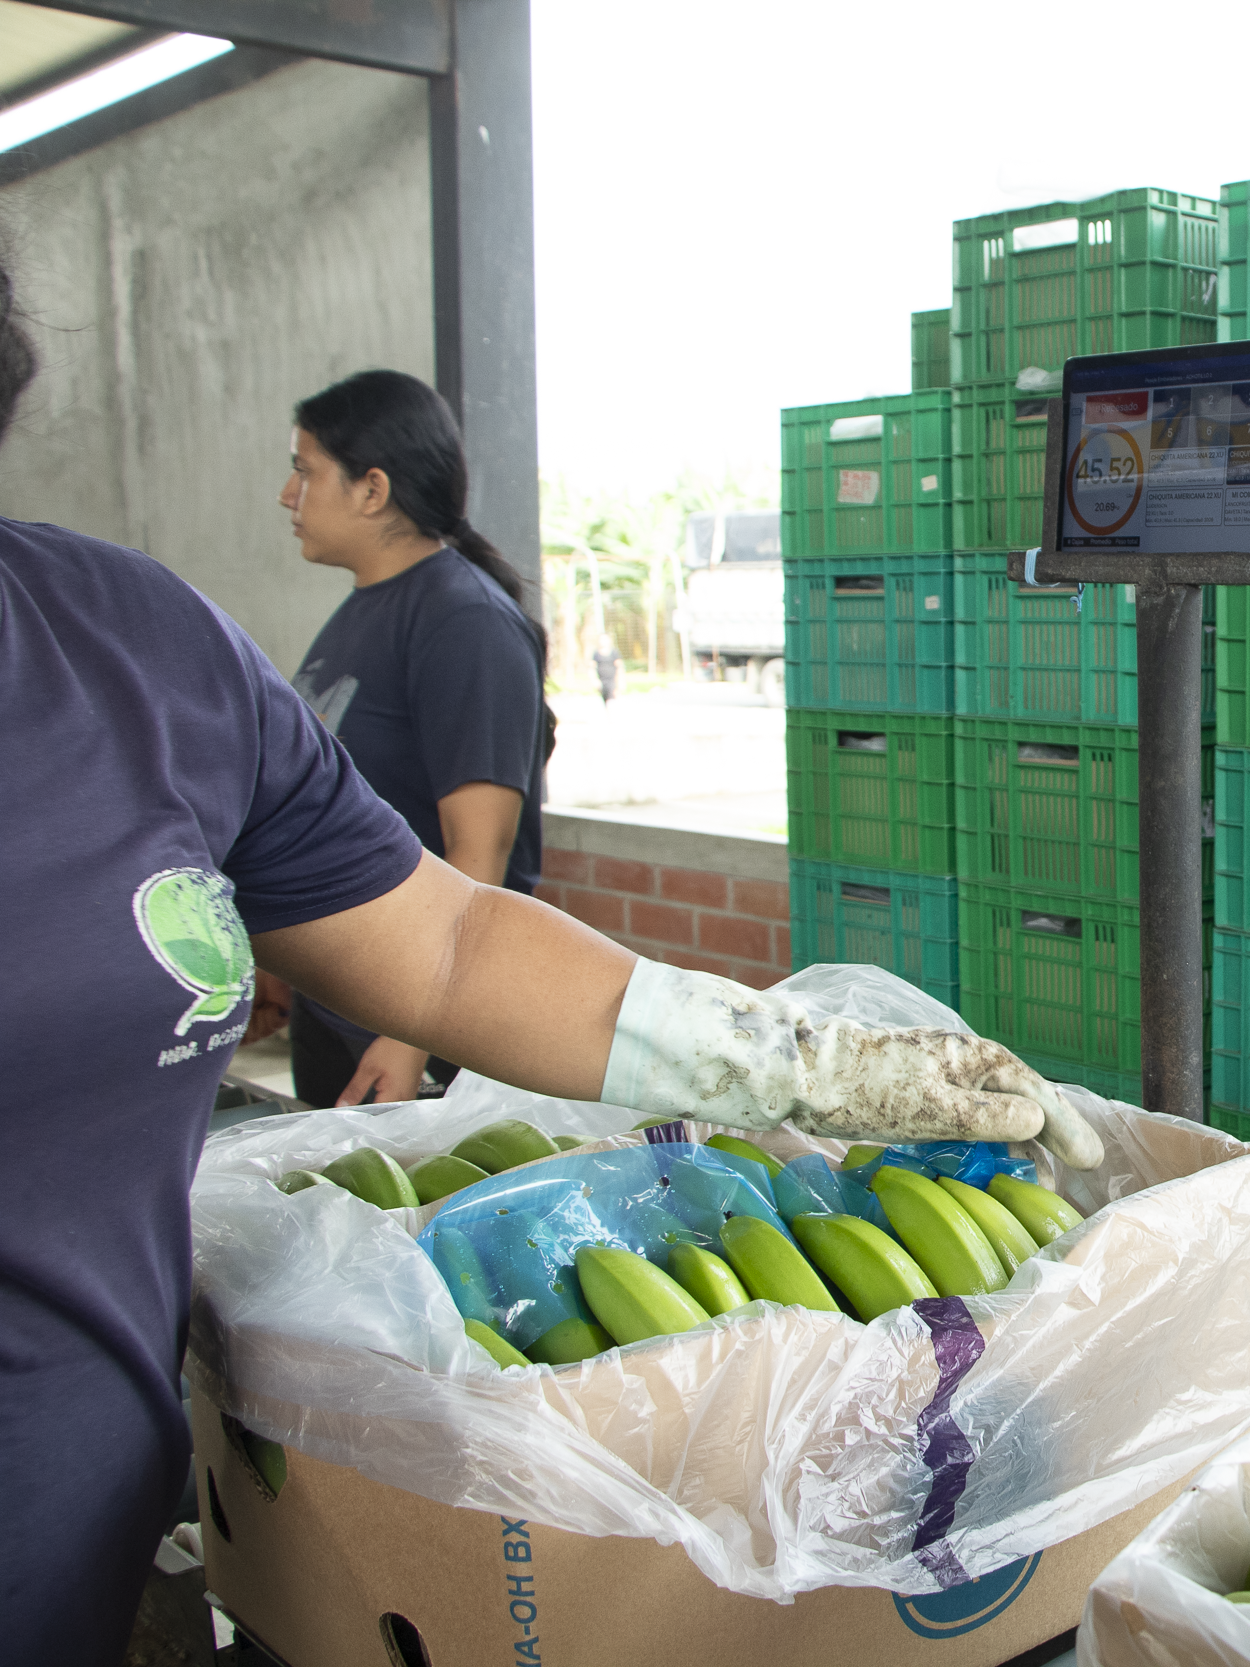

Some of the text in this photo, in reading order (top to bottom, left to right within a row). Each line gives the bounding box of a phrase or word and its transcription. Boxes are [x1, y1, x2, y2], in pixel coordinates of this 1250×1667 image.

[1208, 395, 1214, 405] 2
[1101, 402, 1139, 413] Repesado
[1167, 428, 1173, 438] 5
[1206, 426, 1212, 436] 6
[1176, 452, 1208, 460] AMERICANA
[1076, 456, 1135, 485] 45.52
[1148, 493, 1173, 501] CHIQUITA
[1094, 502, 1115, 512] 20.69
